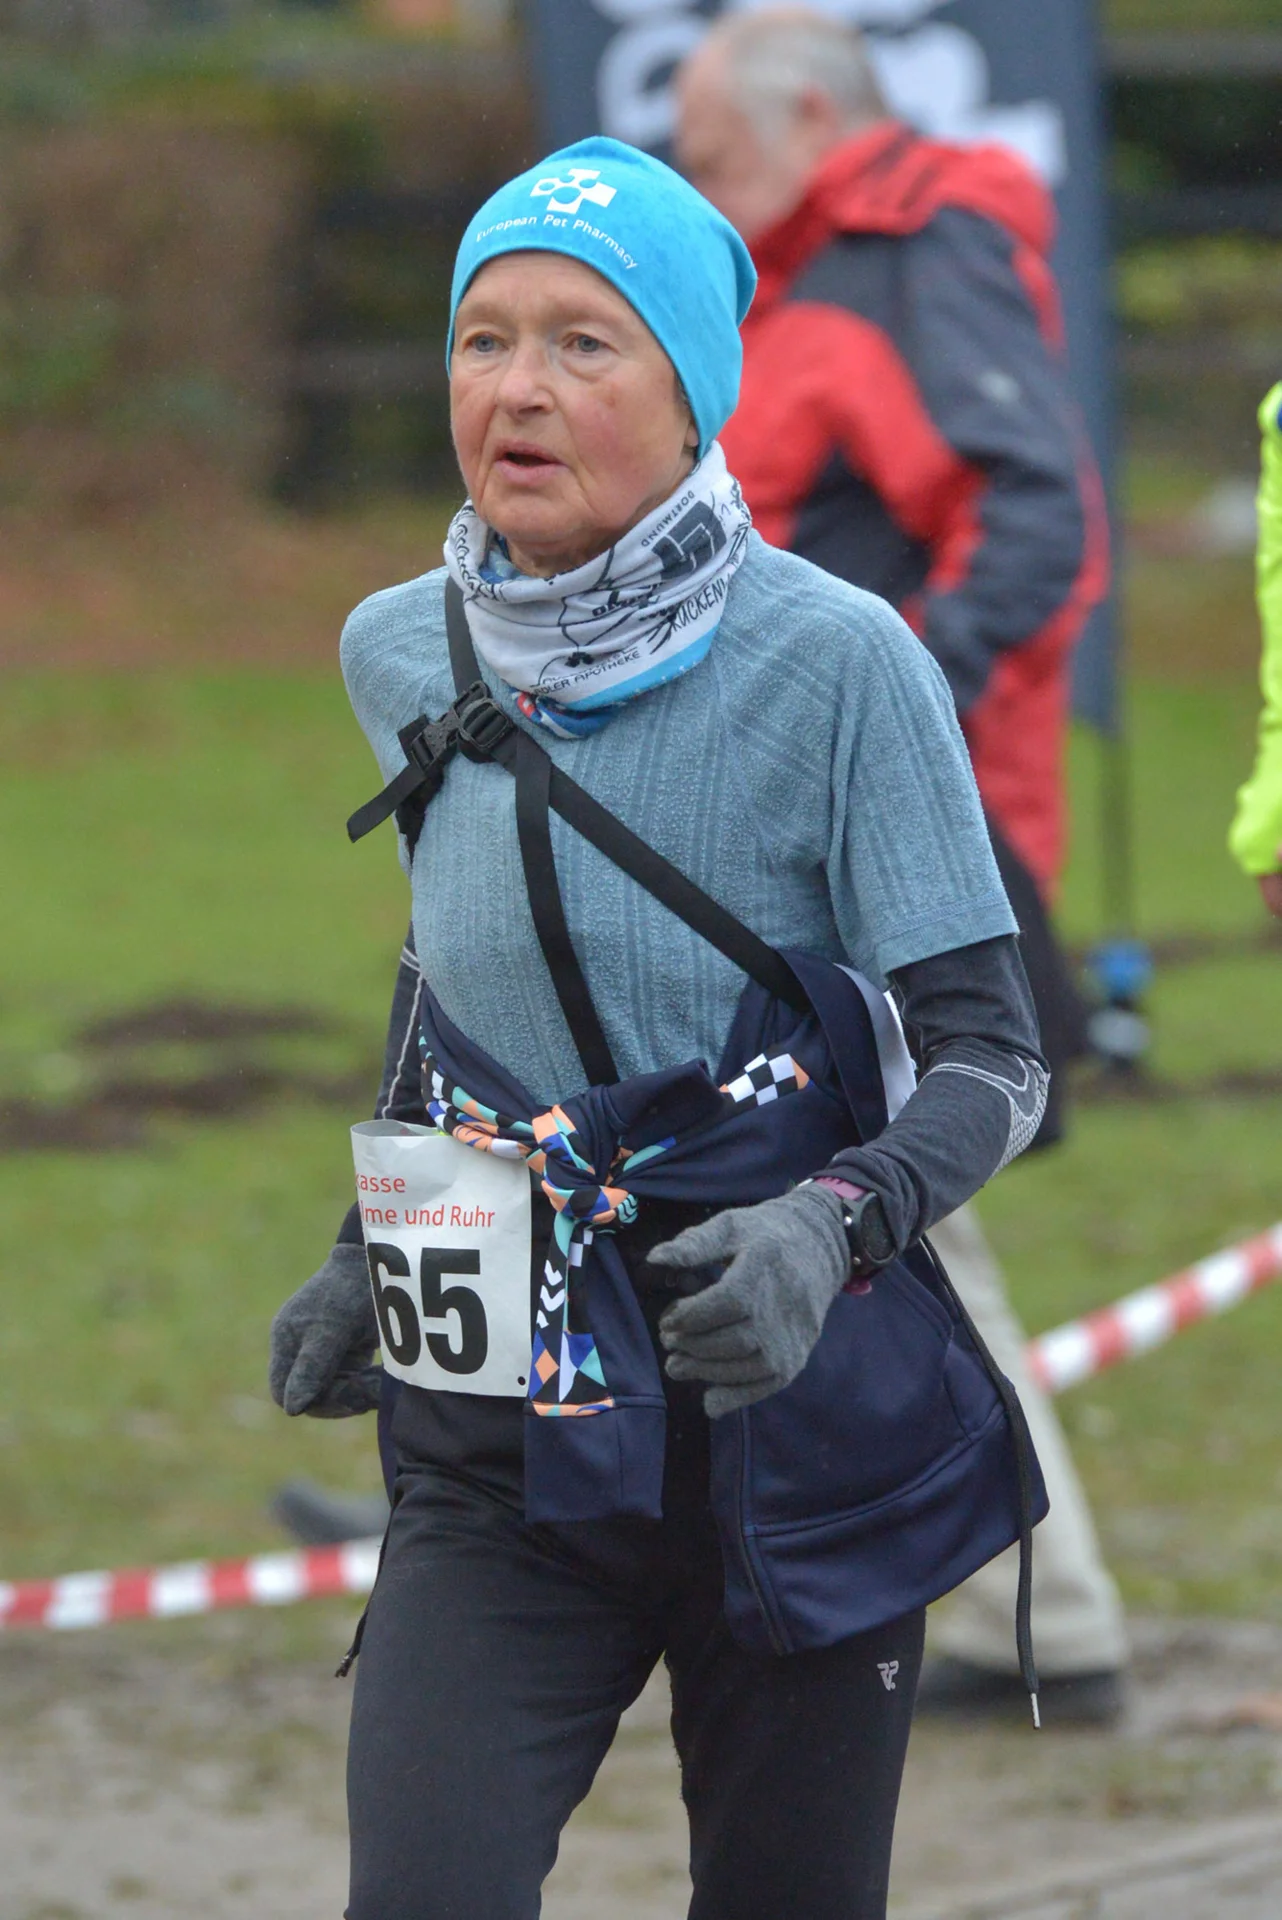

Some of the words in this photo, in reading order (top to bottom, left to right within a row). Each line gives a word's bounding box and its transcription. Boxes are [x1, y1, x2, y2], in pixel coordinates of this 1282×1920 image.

[476, 216, 537, 242] European
[543, 214, 568, 227] Pet
[573, 219, 638, 270] Pharmacy
[641, 490, 695, 547] DORTMUND
[404, 1204, 445, 1226] und
[450, 1205, 496, 1227] Ruhr
[367, 1242, 488, 1375] 65
